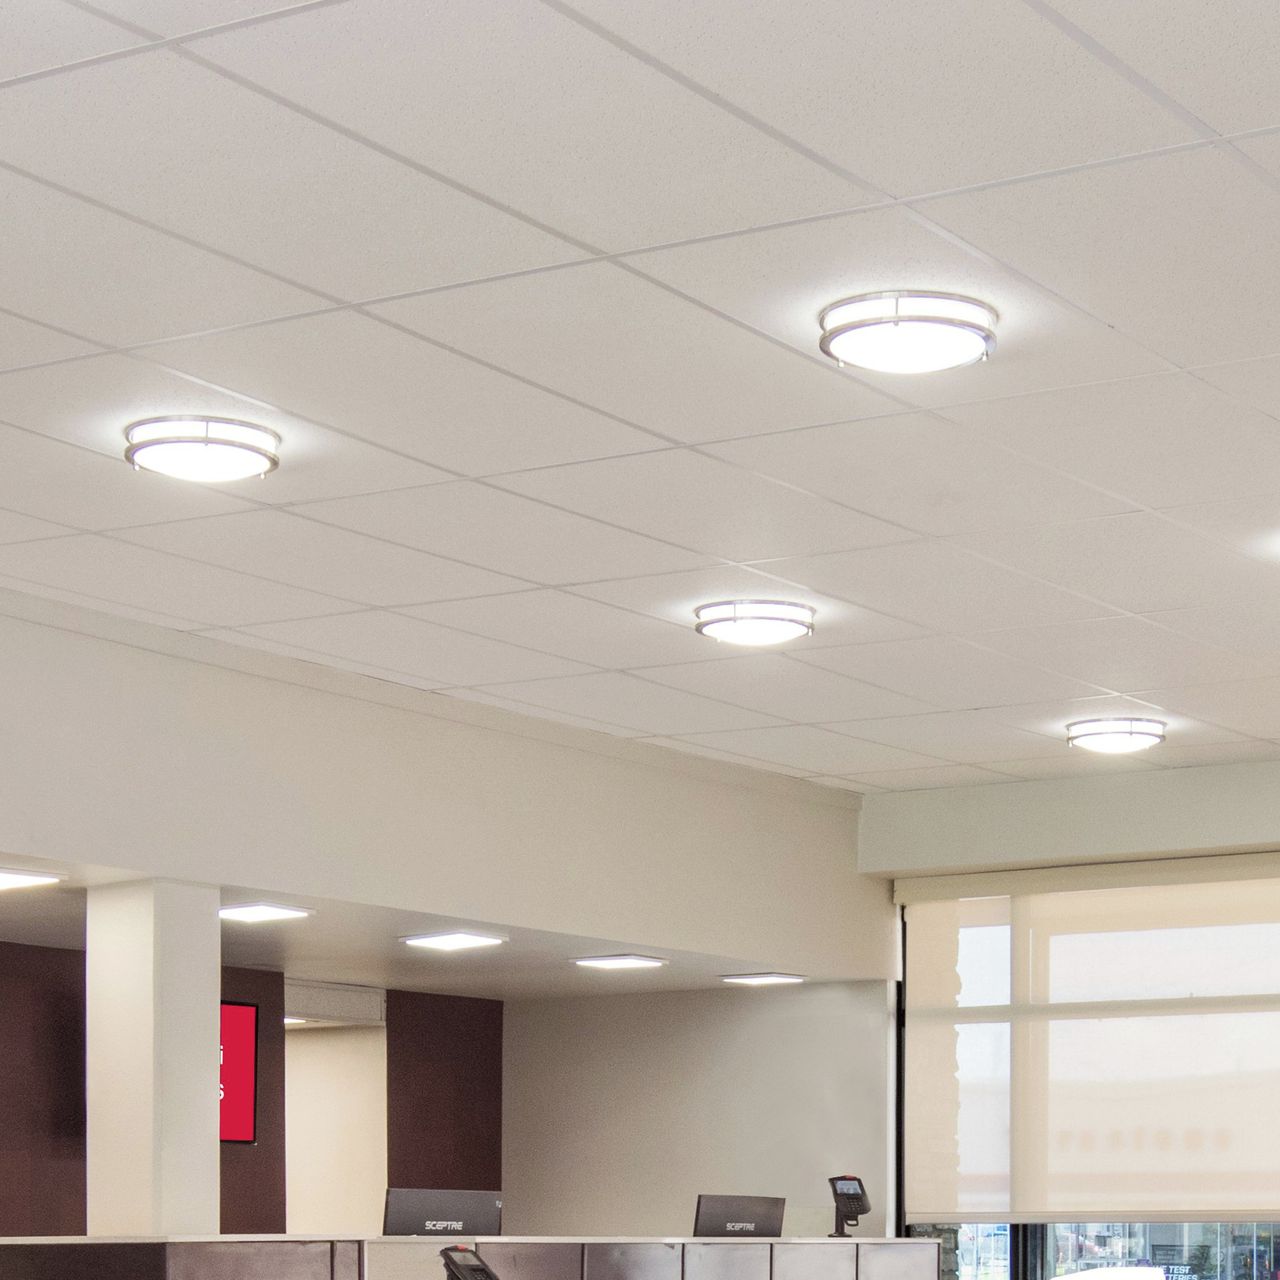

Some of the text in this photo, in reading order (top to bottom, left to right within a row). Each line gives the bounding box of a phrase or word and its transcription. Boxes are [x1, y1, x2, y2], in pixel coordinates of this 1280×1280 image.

[424, 1220, 464, 1231] SCEPTRE
[726, 1222, 755, 1231] SCEPTRE
[1169, 1265, 1191, 1274] TEST
